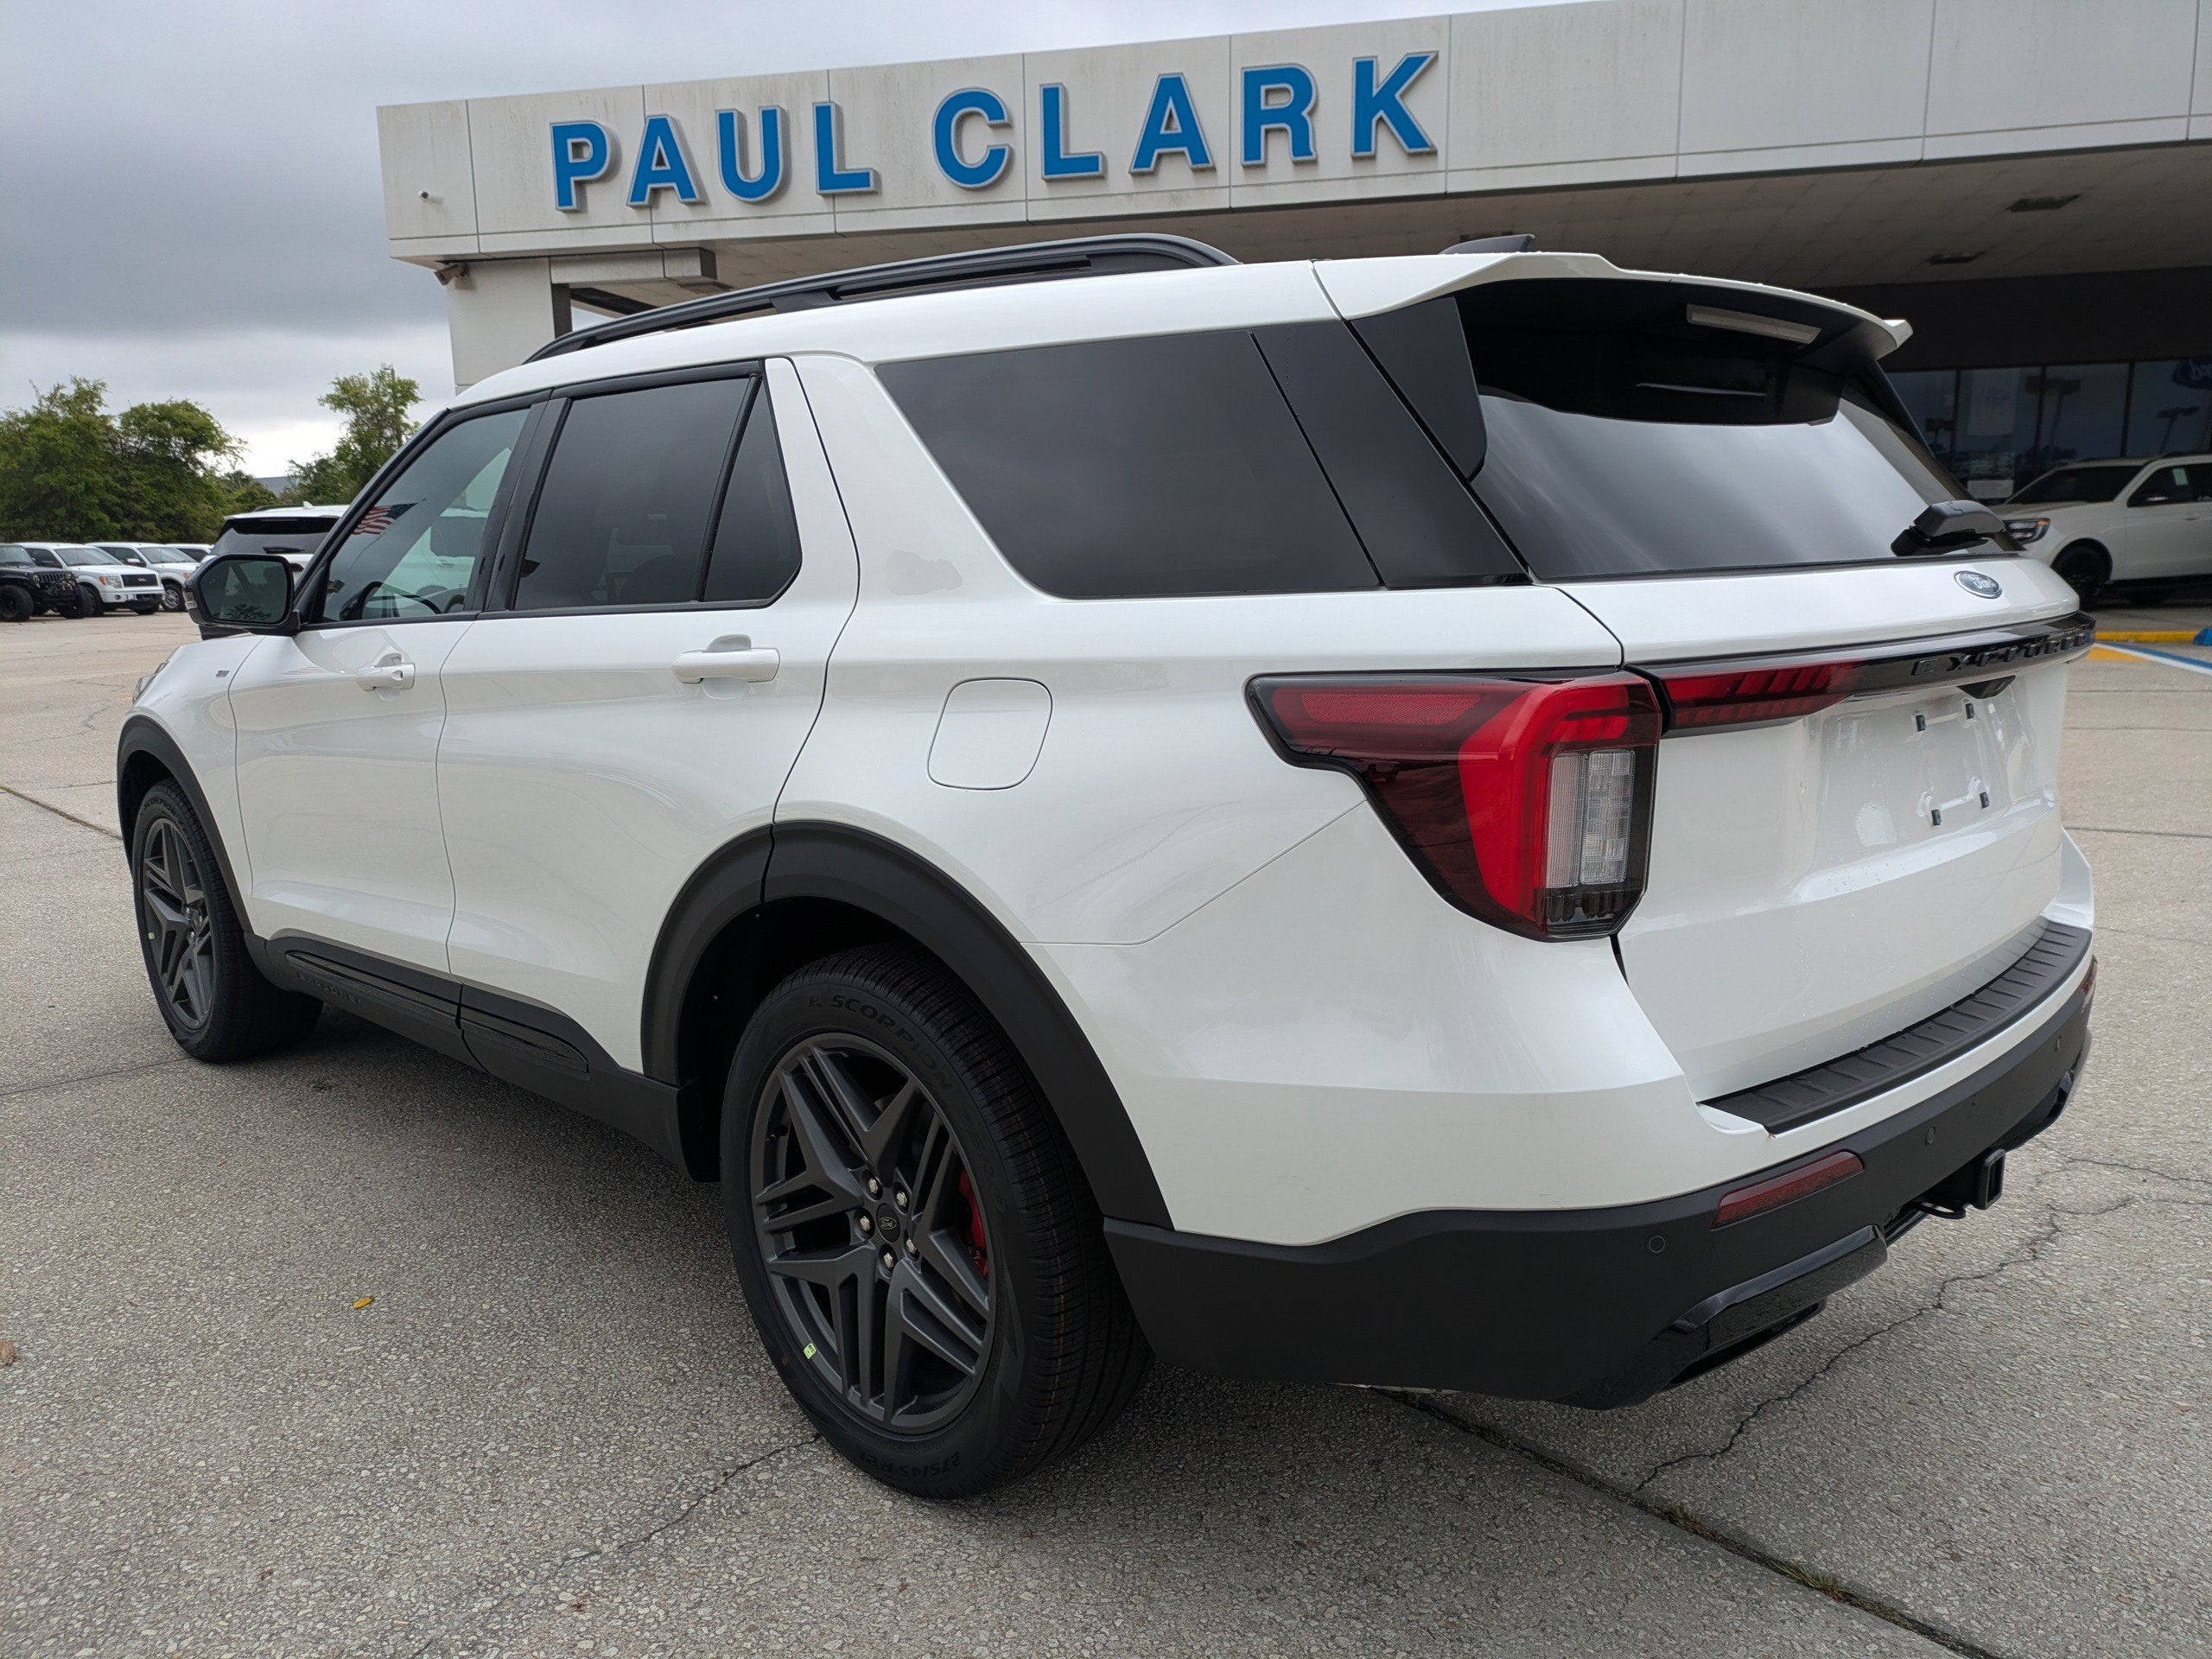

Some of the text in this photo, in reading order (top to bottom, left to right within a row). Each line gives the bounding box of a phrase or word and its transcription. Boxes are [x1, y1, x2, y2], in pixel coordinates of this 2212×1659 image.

[550, 51, 1439, 213] PAUL CLARK
[830, 995, 954, 1090] SCORPION
